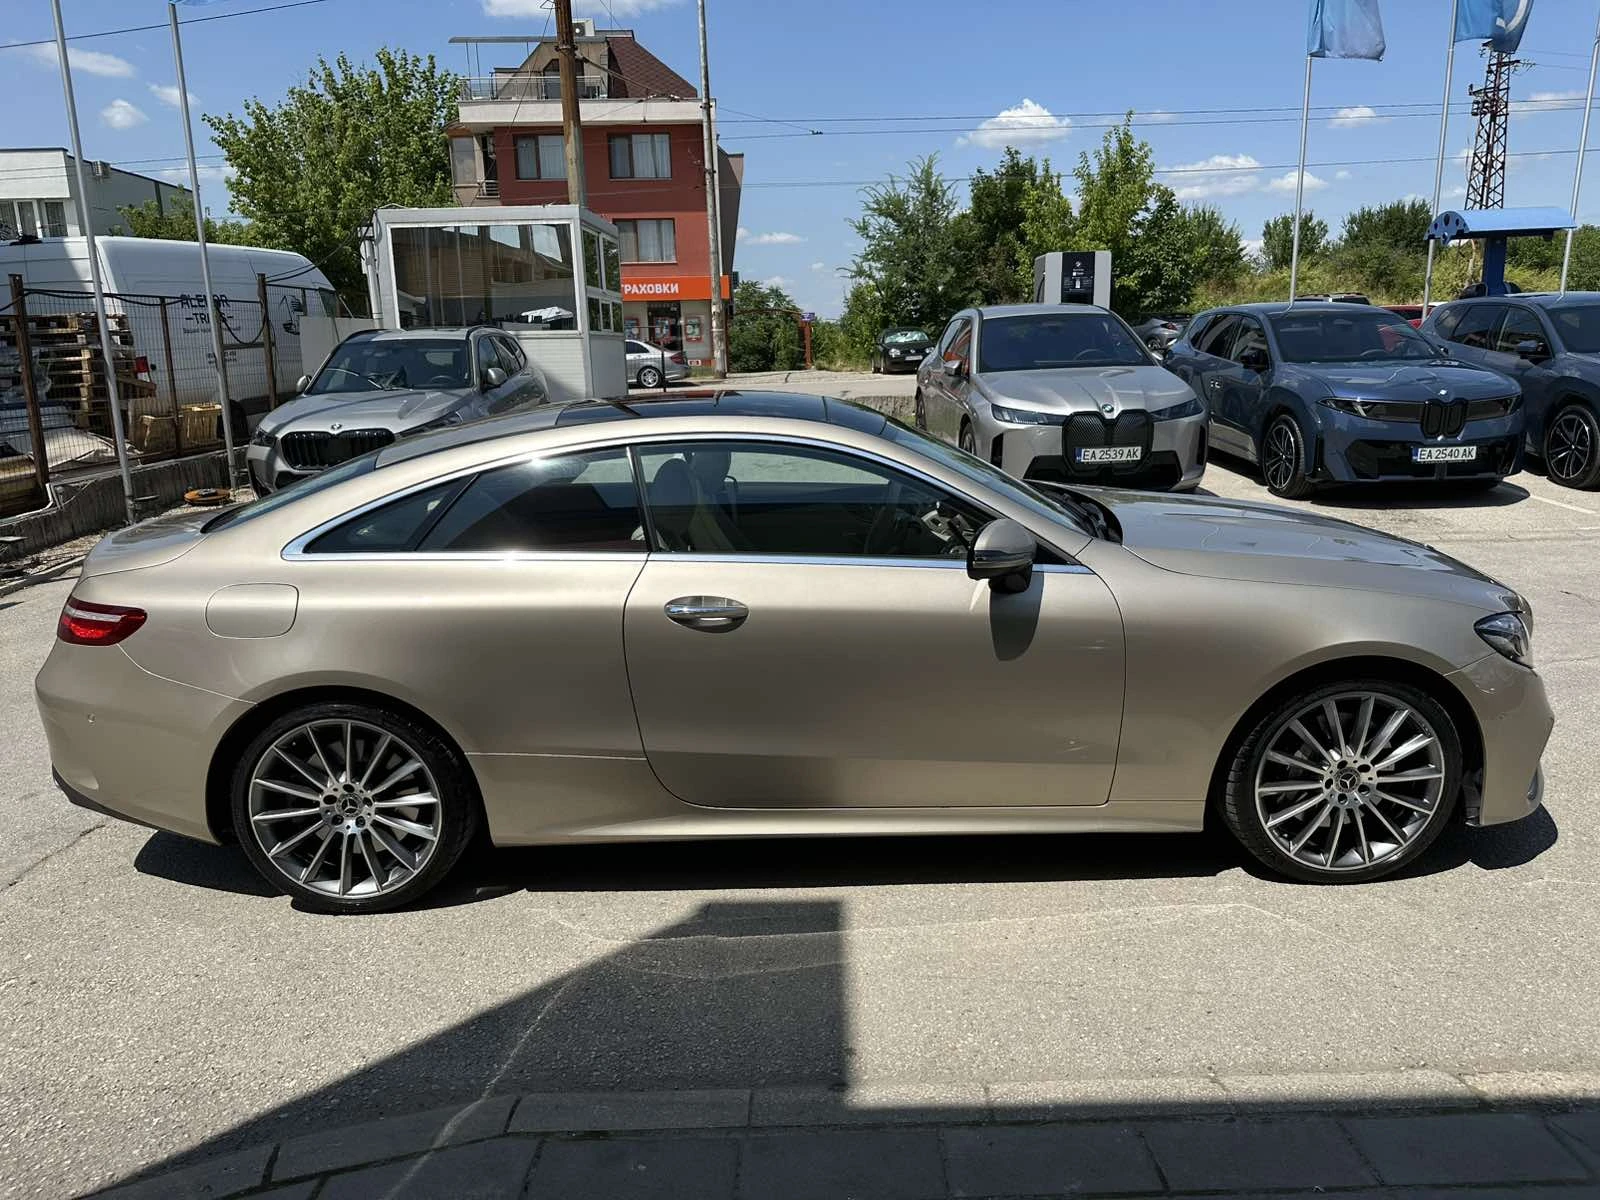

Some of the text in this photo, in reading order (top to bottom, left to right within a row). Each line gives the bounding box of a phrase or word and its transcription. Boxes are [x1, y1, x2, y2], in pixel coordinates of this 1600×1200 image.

[621, 283, 679, 294] РАХОВКИ
[1084, 448, 1139, 460] EA 2539 AK
[1420, 447, 1474, 460] EA 2540 AK
